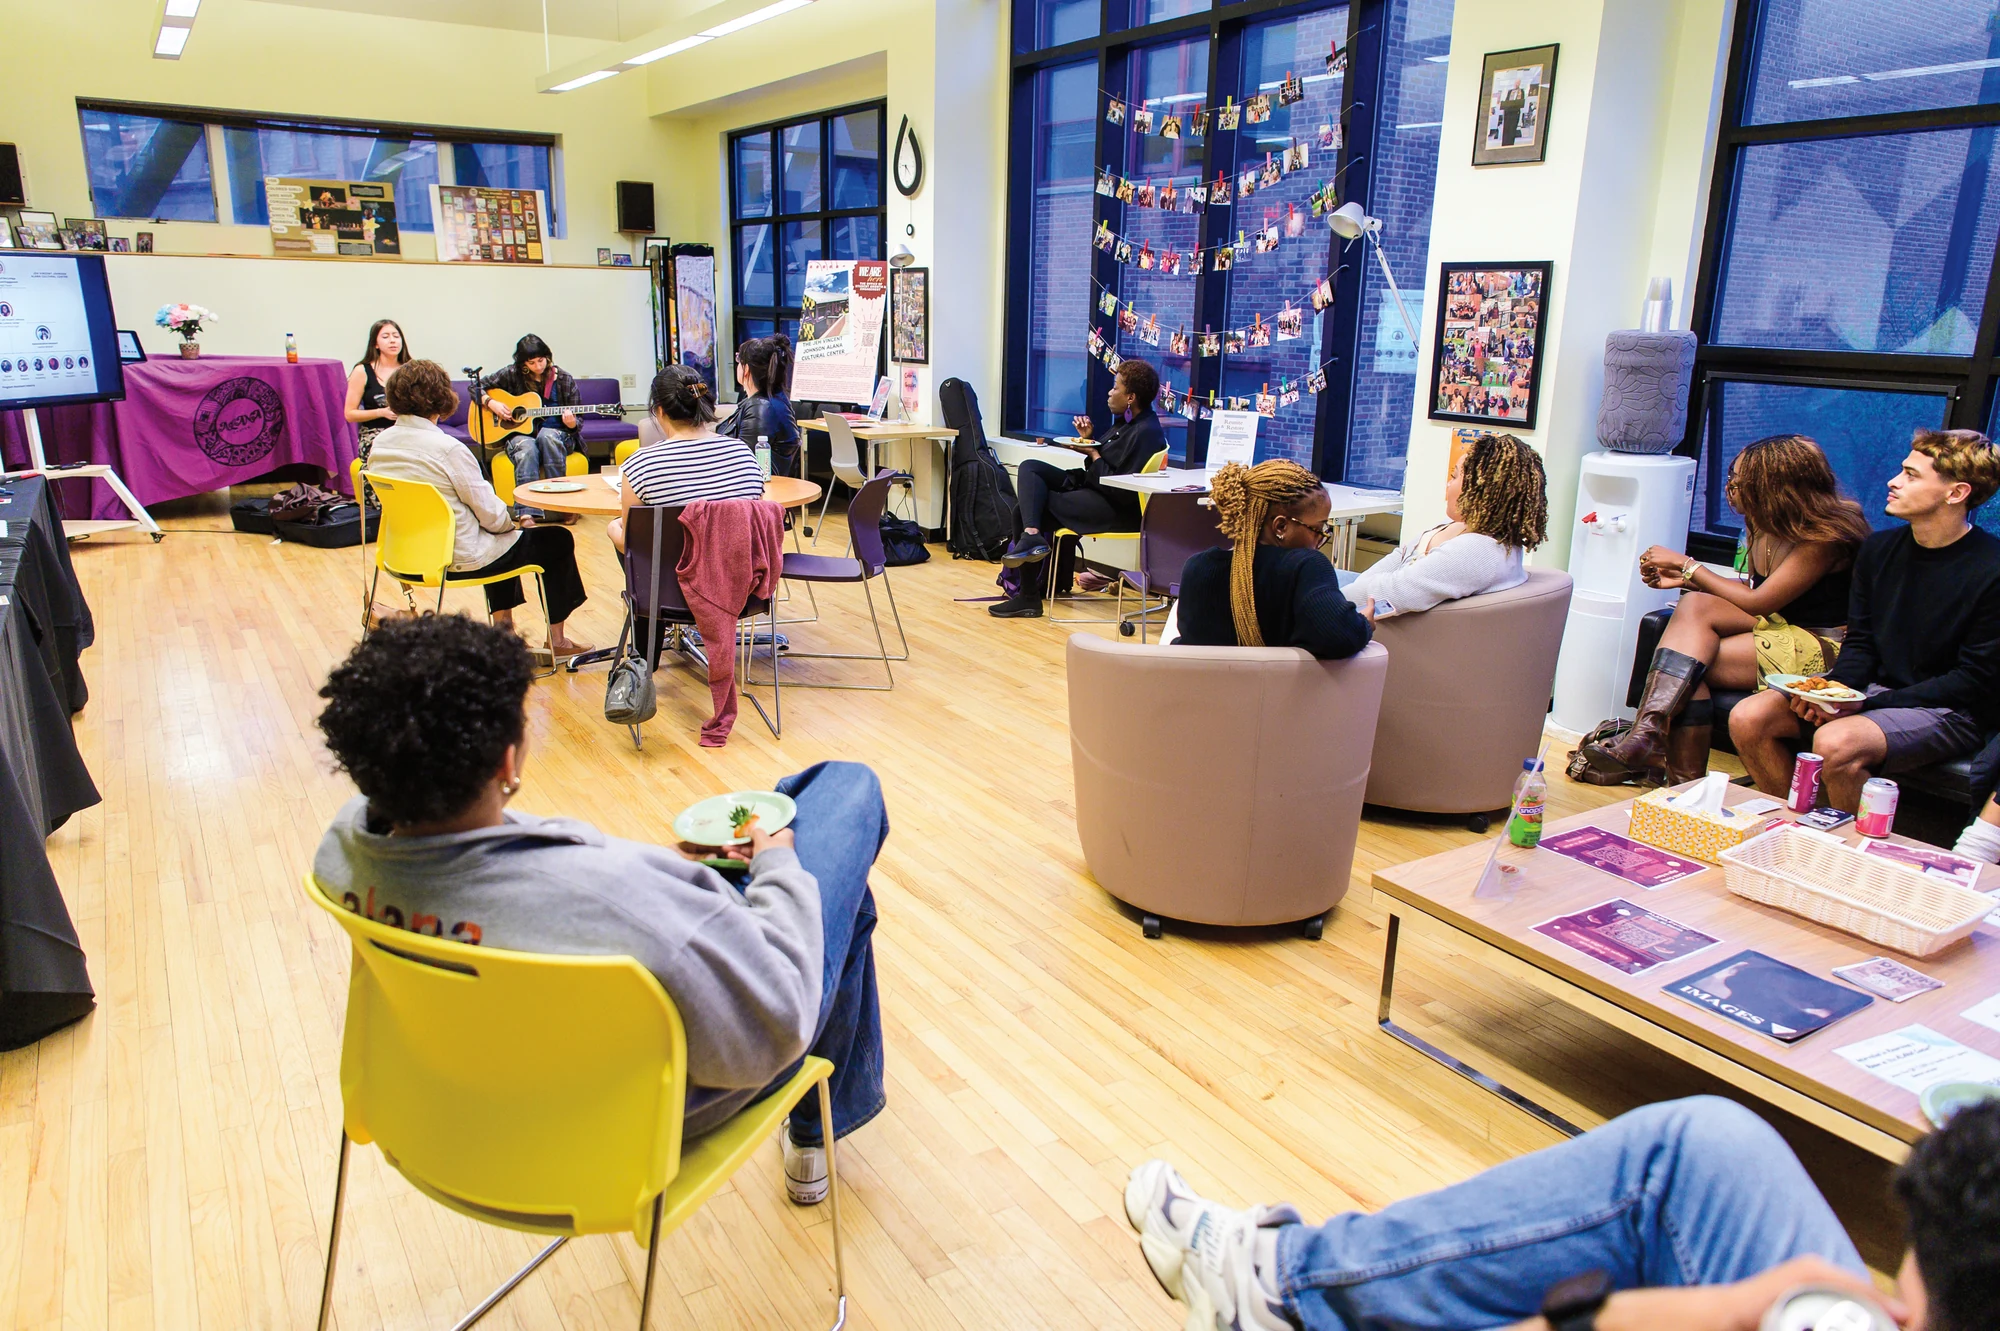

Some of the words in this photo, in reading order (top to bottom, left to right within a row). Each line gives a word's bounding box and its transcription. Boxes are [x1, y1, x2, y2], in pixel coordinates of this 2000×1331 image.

[859, 266, 870, 276] WE
[870, 266, 882, 276] ARE
[801, 353, 825, 361] CULTURAL
[826, 349, 845, 357] CENTER
[803, 346, 825, 354] JOHNSON
[1520, 805, 1544, 815] snapp
[1680, 985, 1765, 1025] IMAGES
